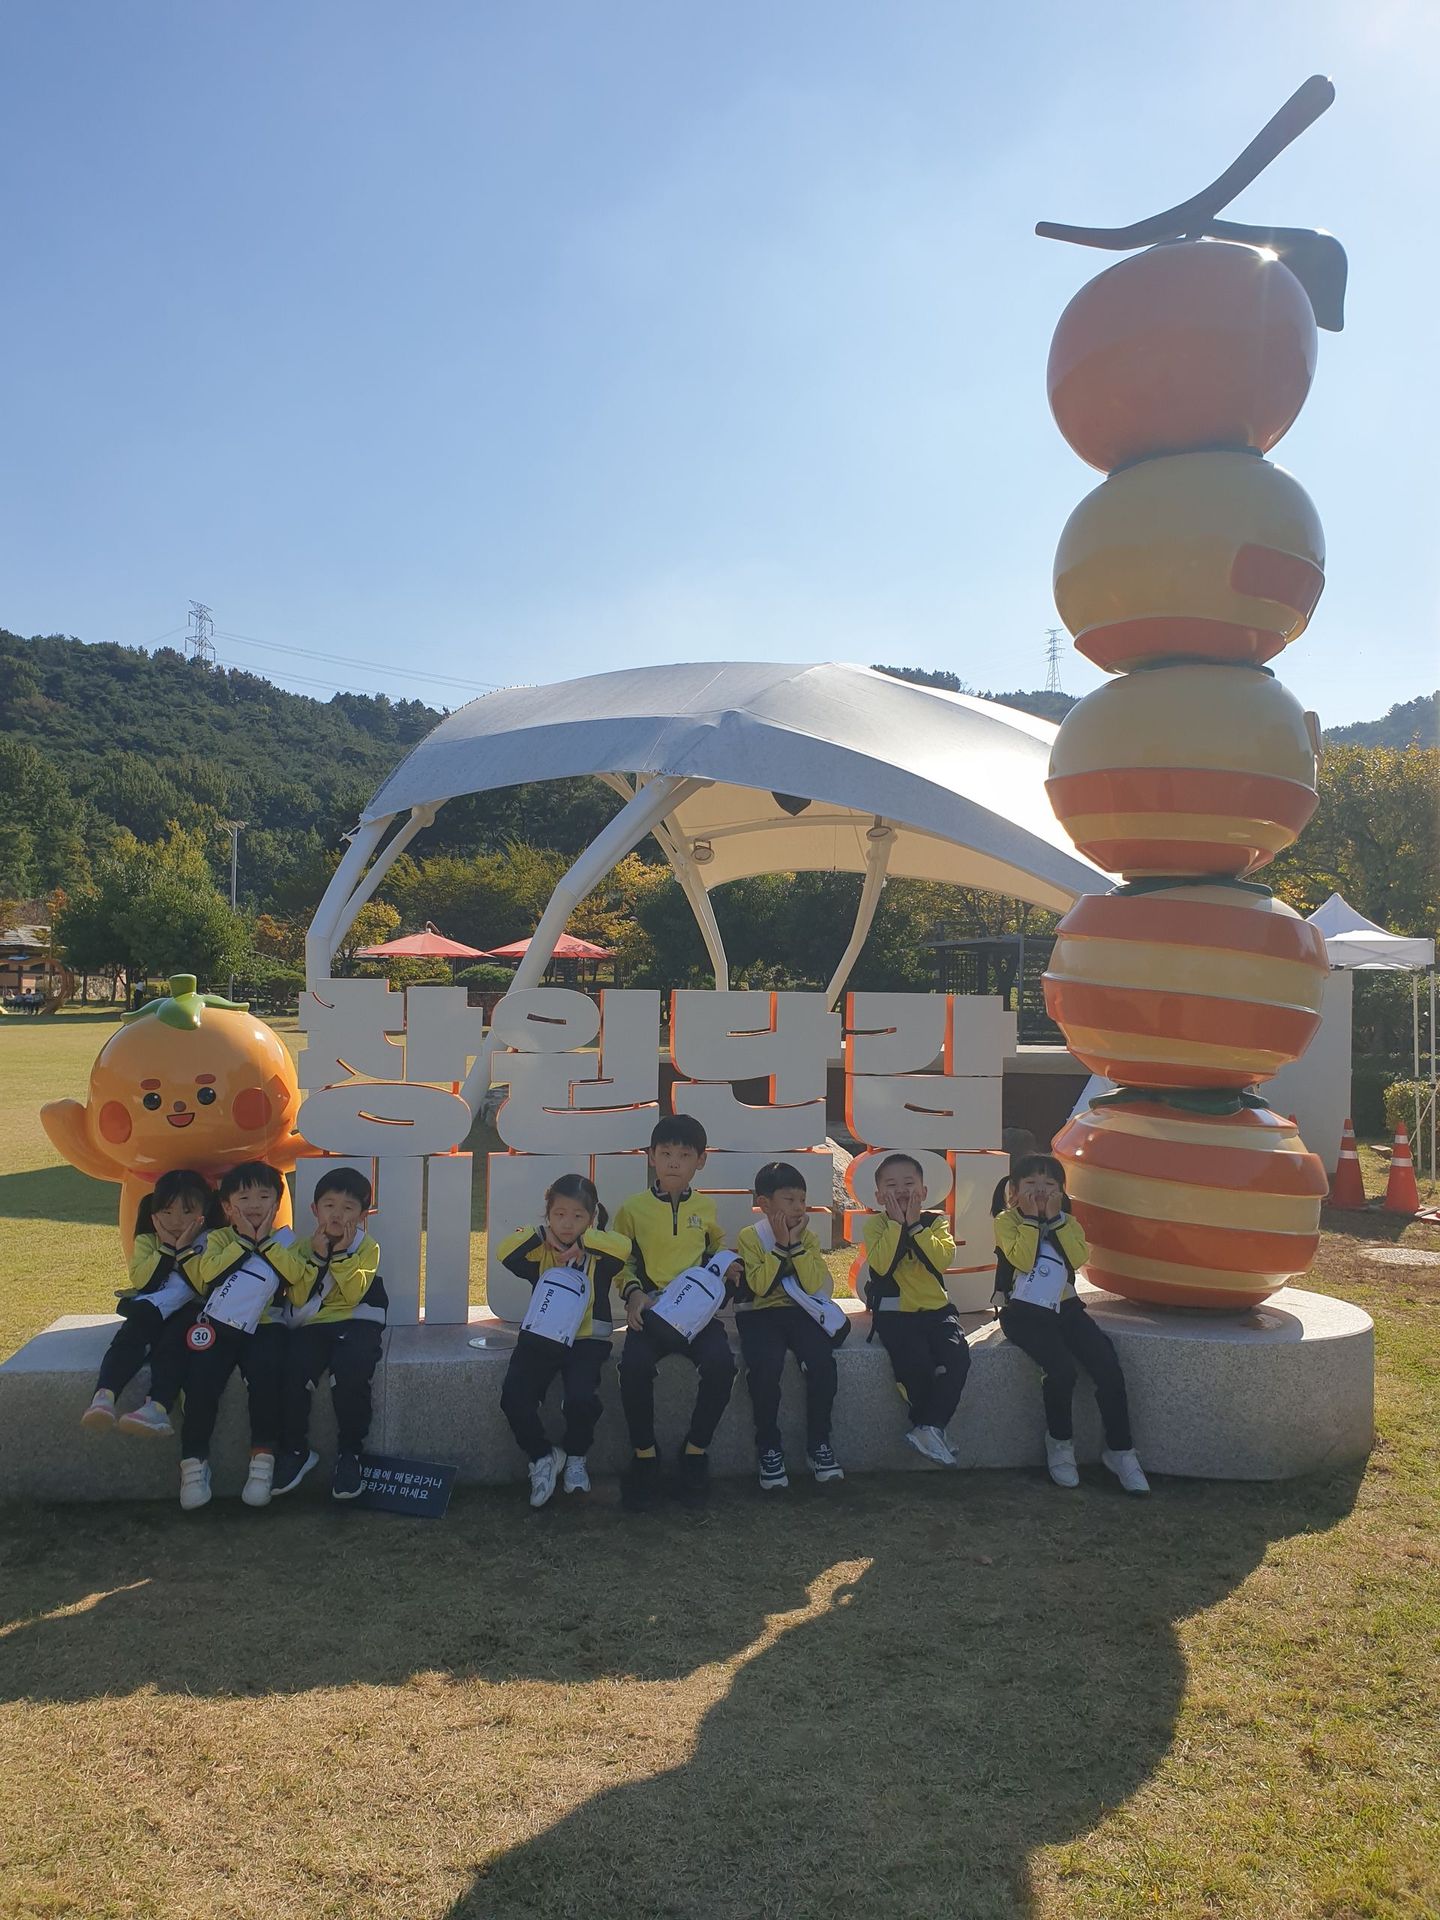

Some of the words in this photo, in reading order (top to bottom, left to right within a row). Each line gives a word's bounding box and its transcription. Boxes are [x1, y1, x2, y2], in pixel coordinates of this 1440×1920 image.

[297, 978, 1017, 1156] 창원단감
[219, 1274, 238, 1298] BLACK
[674, 1284, 692, 1305] BLACK
[540, 1289, 554, 1314] BLACK
[194, 1331, 208, 1341] 30
[363, 1466, 392, 1481] 형물에
[394, 1472, 442, 1489] 매달리거나
[399, 1486, 430, 1500] 마세요
